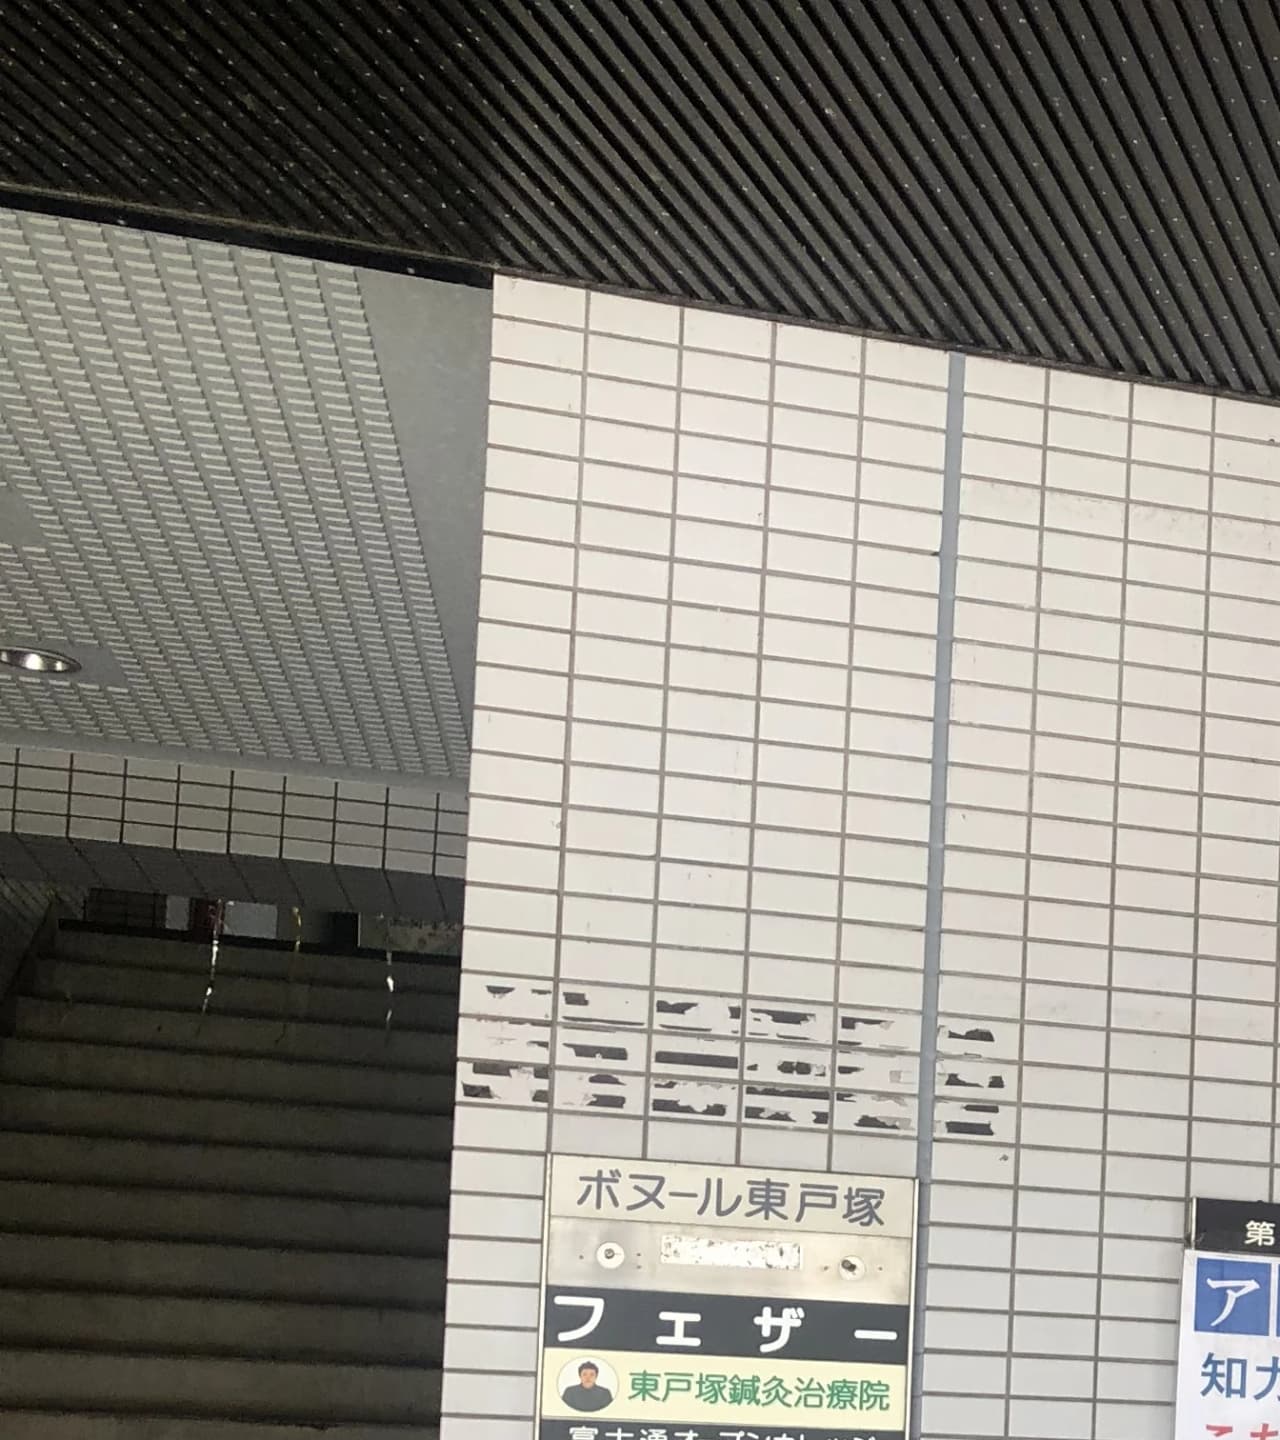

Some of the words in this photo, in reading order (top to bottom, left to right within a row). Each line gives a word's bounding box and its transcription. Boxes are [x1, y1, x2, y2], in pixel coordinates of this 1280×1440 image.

[577, 1168, 885, 1227] ボヌール東戸塚
[627, 1370, 891, 1412] 東戸塚鍼灸治療院
